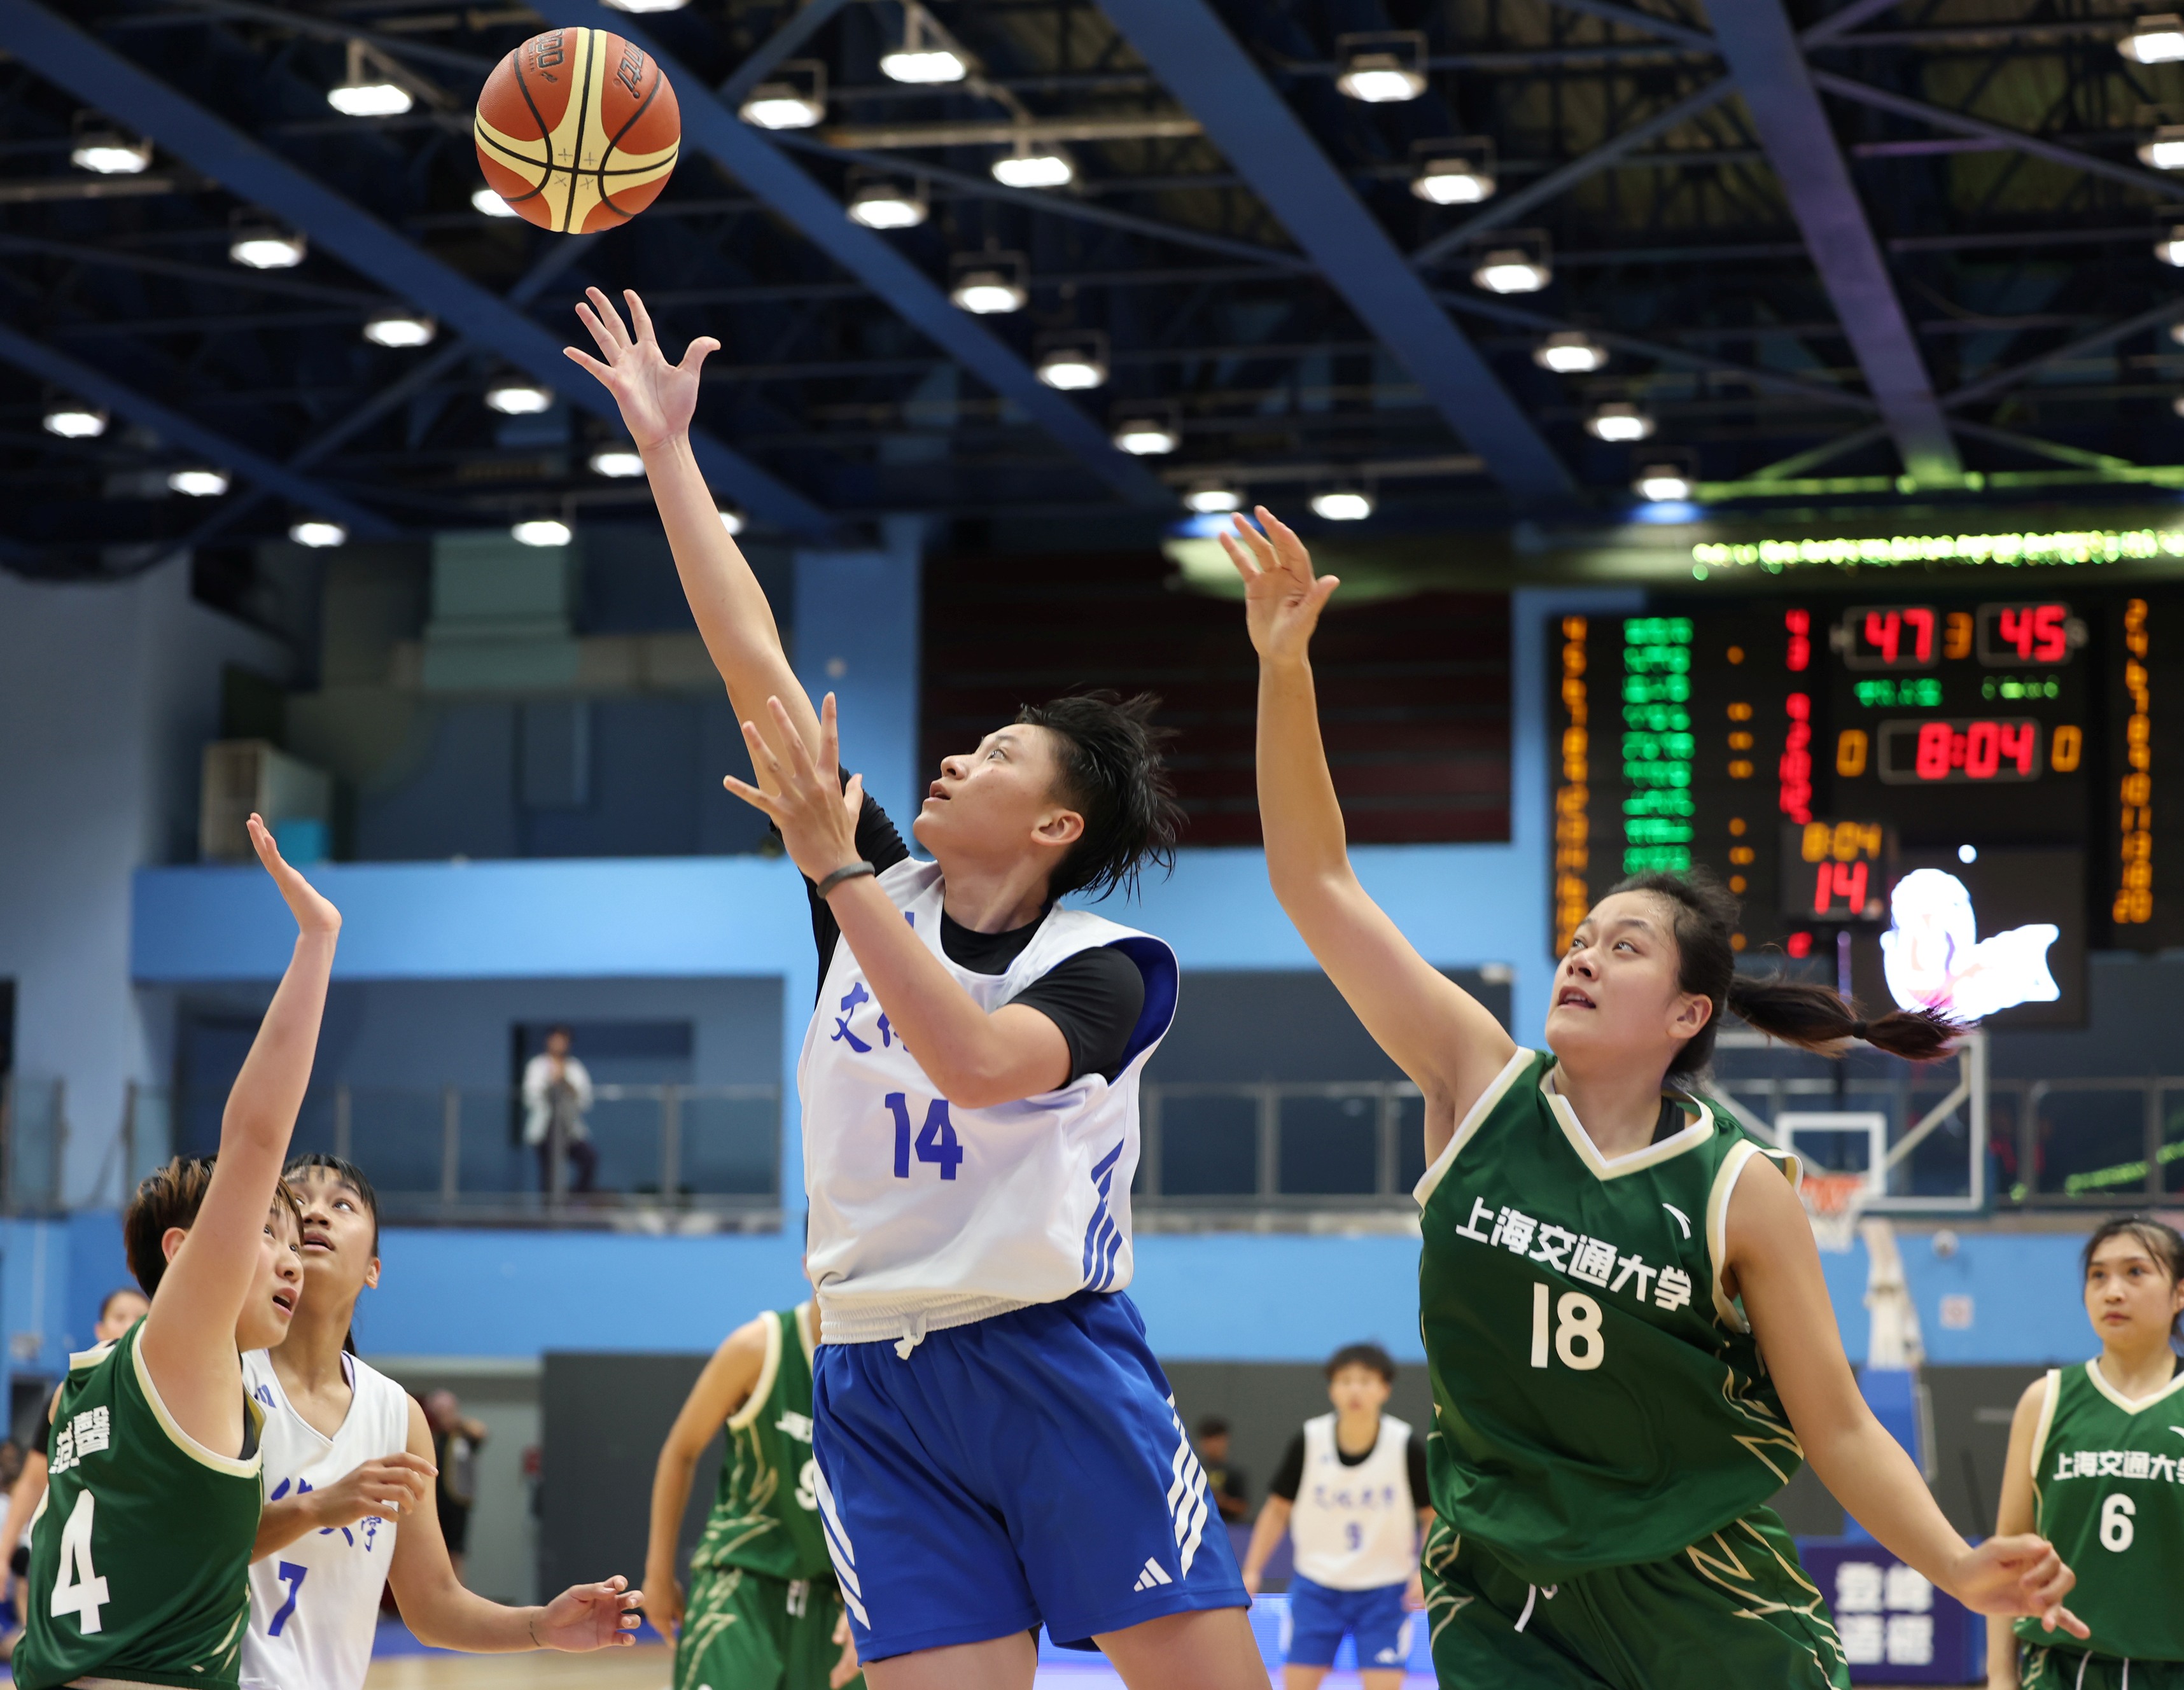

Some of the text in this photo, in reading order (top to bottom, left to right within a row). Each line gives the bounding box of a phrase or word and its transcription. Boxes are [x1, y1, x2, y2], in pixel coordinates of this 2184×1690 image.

[1865, 608, 1934, 663] 47
[1943, 612, 1973, 660] 3
[1999, 604, 2066, 662] 45
[1835, 729, 1868, 777] 0
[1915, 721, 2035, 780] 8:04
[2050, 725, 2083, 772] 0
[1802, 821, 1882, 863] 8:04
[1814, 861, 1869, 915] 14
[885, 1092, 963, 1180] 14
[1455, 1196, 1691, 1311] 上海交通大学
[1530, 1282, 1604, 1371] 18
[2099, 1493, 2136, 1553] 6
[50, 1488, 110, 1635] 4
[267, 1561, 308, 1637] 7
